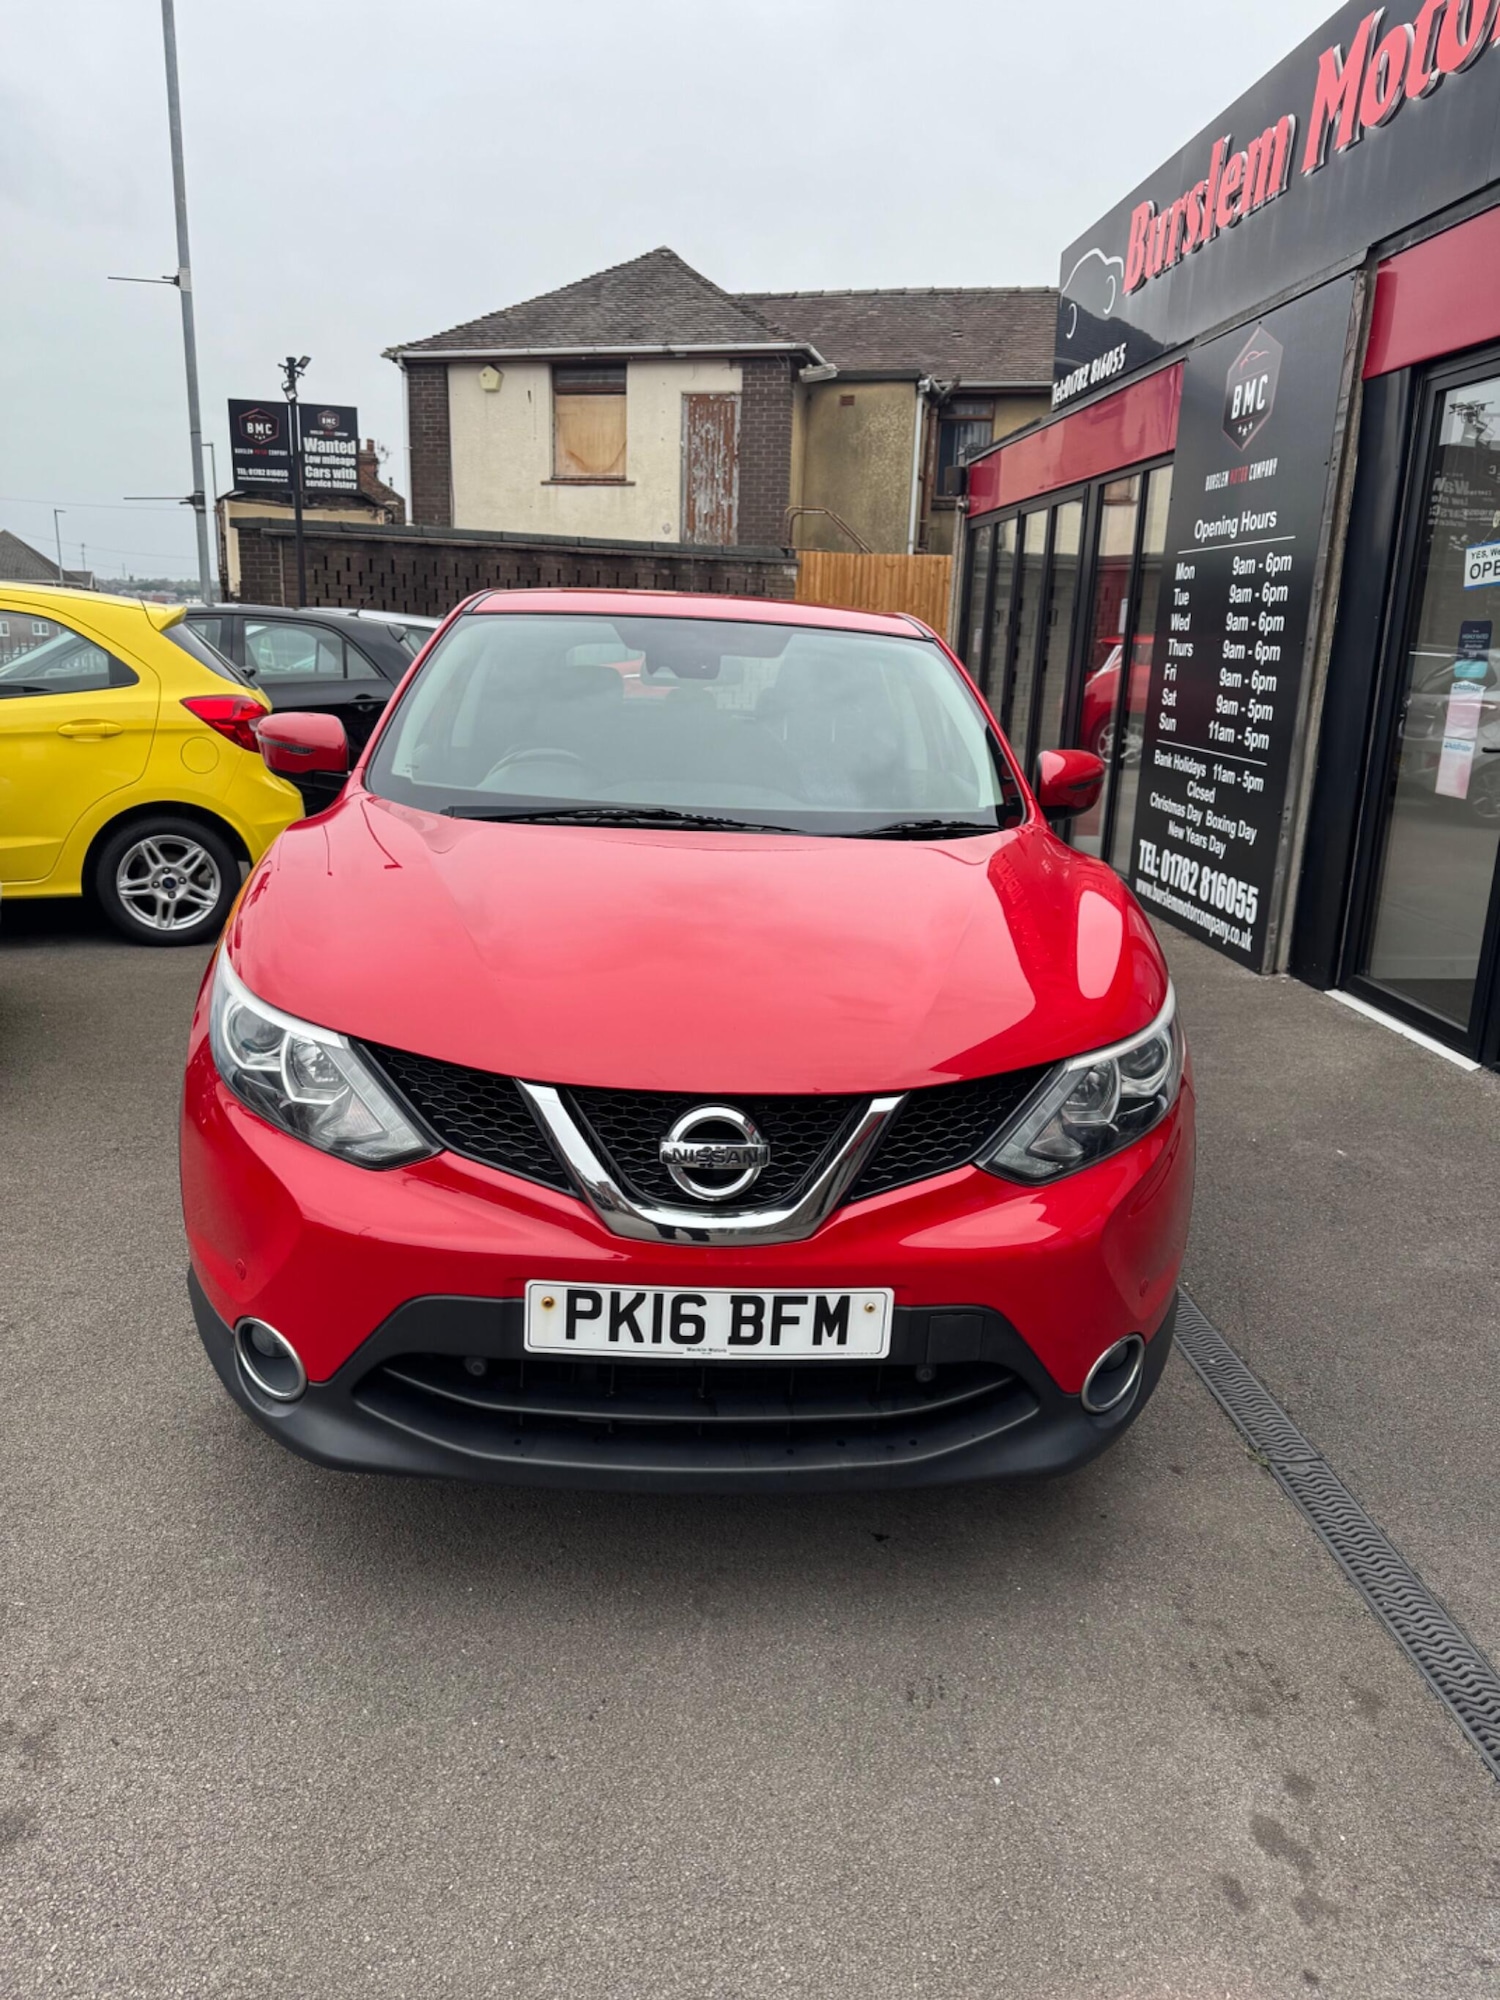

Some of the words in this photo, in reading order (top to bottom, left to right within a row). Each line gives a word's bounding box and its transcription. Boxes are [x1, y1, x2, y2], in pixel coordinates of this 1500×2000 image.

[1122, 114, 1297, 296] Burslem
[1301, 0, 1500, 176] Moto
[1090, 342, 1127, 384] 816055
[1231, 374, 1268, 420] BMC
[246, 422, 273, 435] BMC
[303, 437, 357, 455] Wanted
[304, 453, 321, 464] Low
[322, 455, 356, 467] mileage
[305, 465, 331, 479] Cars
[332, 467, 357, 480] with
[305, 479, 331, 489] service
[332, 480, 357, 490] history
[1195, 515, 1239, 543] Opening
[1240, 510, 1278, 534] Hours
[1175, 563, 1195, 580] Mon
[1232, 556, 1255, 575] 9am
[1265, 552, 1293, 578] 6pm
[1173, 588, 1190, 606] Tue
[1229, 584, 1252, 603] 9am
[1262, 582, 1289, 607] 6pm
[1170, 614, 1191, 632] Wed
[1225, 612, 1249, 631] 9am
[1258, 612, 1285, 636] 6pm
[1168, 639, 1194, 657] Thurs
[1222, 640, 1246, 659] 9am
[1254, 640, 1281, 665] 6pm
[1164, 663, 1177, 682] Fri
[1219, 668, 1243, 688] 9am
[1251, 670, 1277, 695] 6pm
[1162, 688, 1178, 707] Sat
[1216, 695, 1239, 715] 9am
[1247, 698, 1273, 723] 5pm
[1159, 712, 1177, 732] Sun
[1208, 720, 1235, 743] 11am
[1244, 728, 1270, 752] 5pm
[1154, 750, 1173, 766] Bank
[1173, 757, 1207, 778] Holidays
[1212, 763, 1236, 784] 11am
[1243, 770, 1265, 793] 5pm
[1187, 780, 1216, 804] Closed
[1150, 792, 1187, 819] Christmas
[1186, 802, 1203, 825] Day
[1205, 810, 1238, 838] Boxing
[1237, 820, 1258, 846] Day
[1168, 820, 1184, 840] New
[1185, 828, 1208, 850] Years
[1208, 835, 1227, 860] Day
[1138, 839, 1160, 879] TEL:
[1160, 848, 1200, 897] 01782
[1199, 865, 1259, 925] 816055
[672, 1147, 758, 1165] NISSAN
[565, 1289, 707, 1345] PK16
[727, 1294, 851, 1346] BFM
